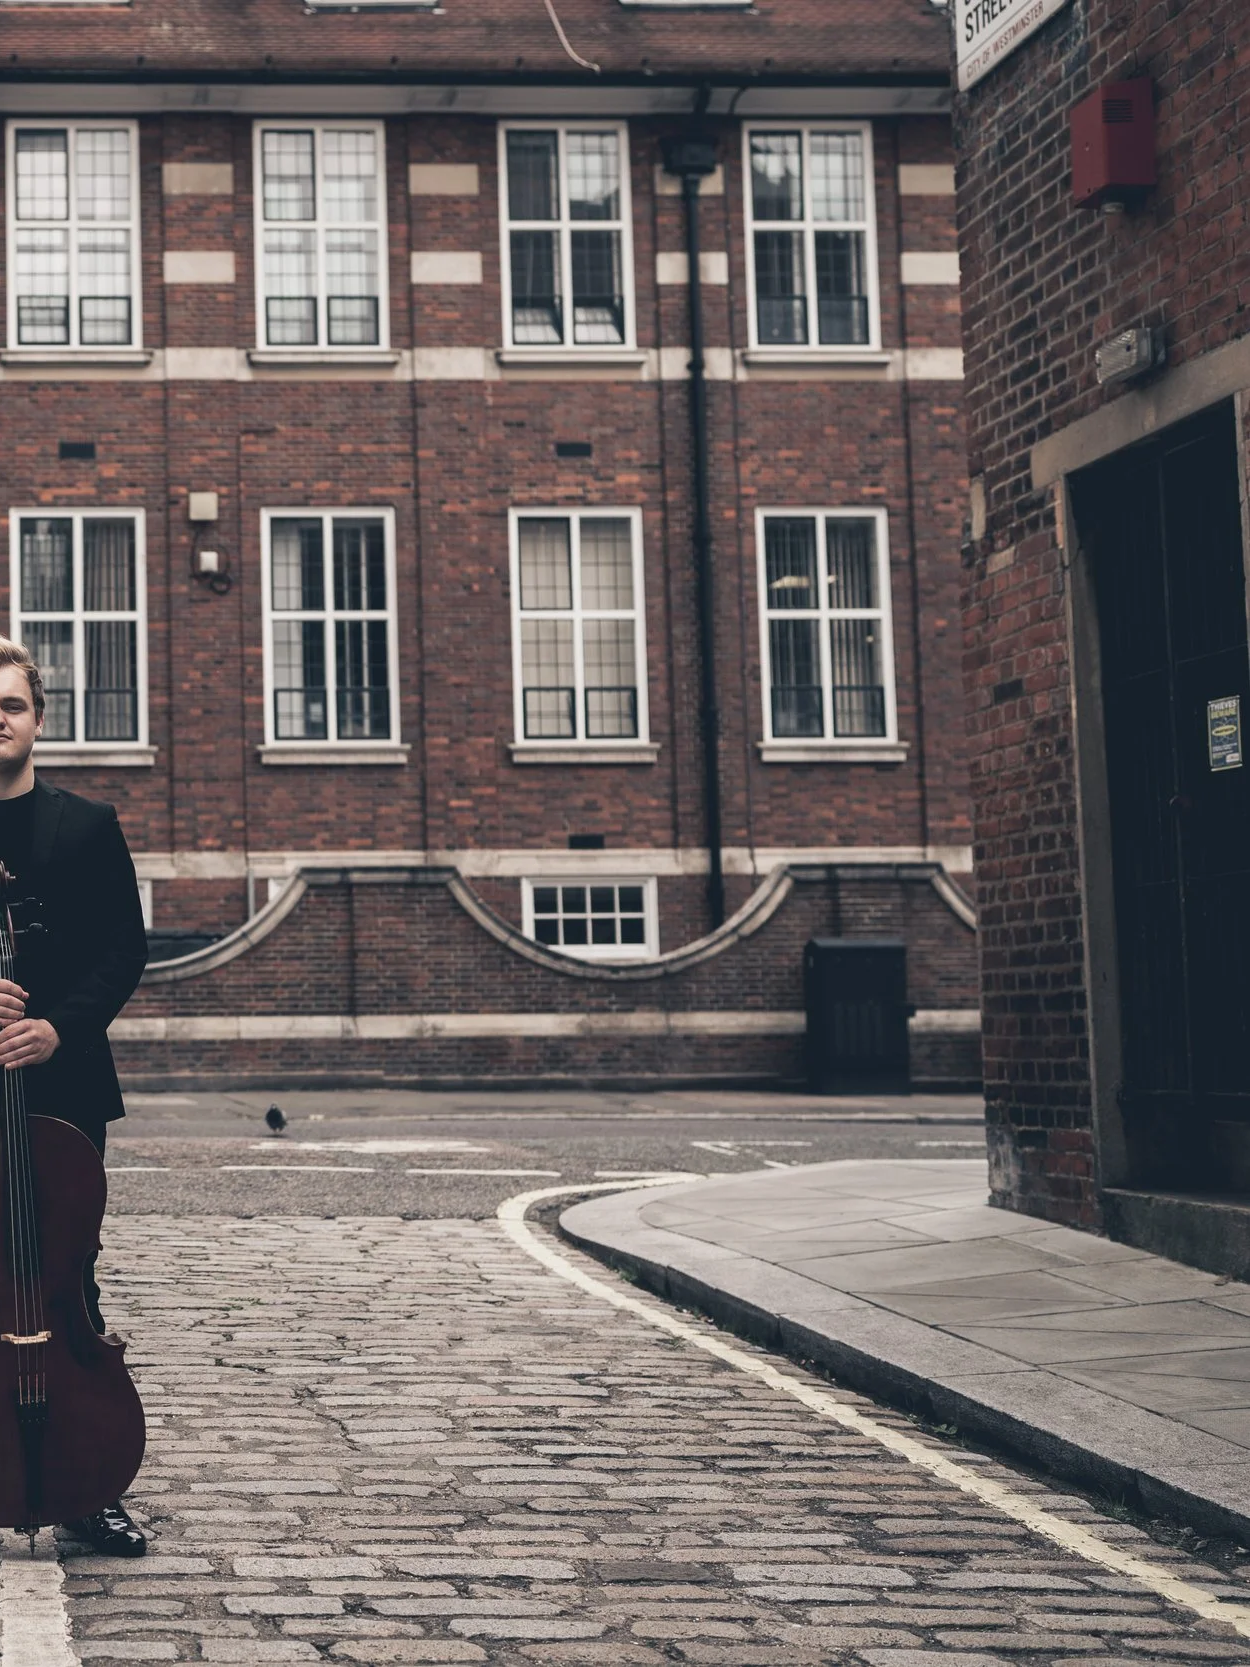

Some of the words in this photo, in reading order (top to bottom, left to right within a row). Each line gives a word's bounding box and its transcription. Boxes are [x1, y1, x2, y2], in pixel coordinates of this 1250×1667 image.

[982, 47, 991, 65] OF
[992, 0, 1044, 55] WESTMINSTER
[1210, 699, 1237, 711] THIEVES
